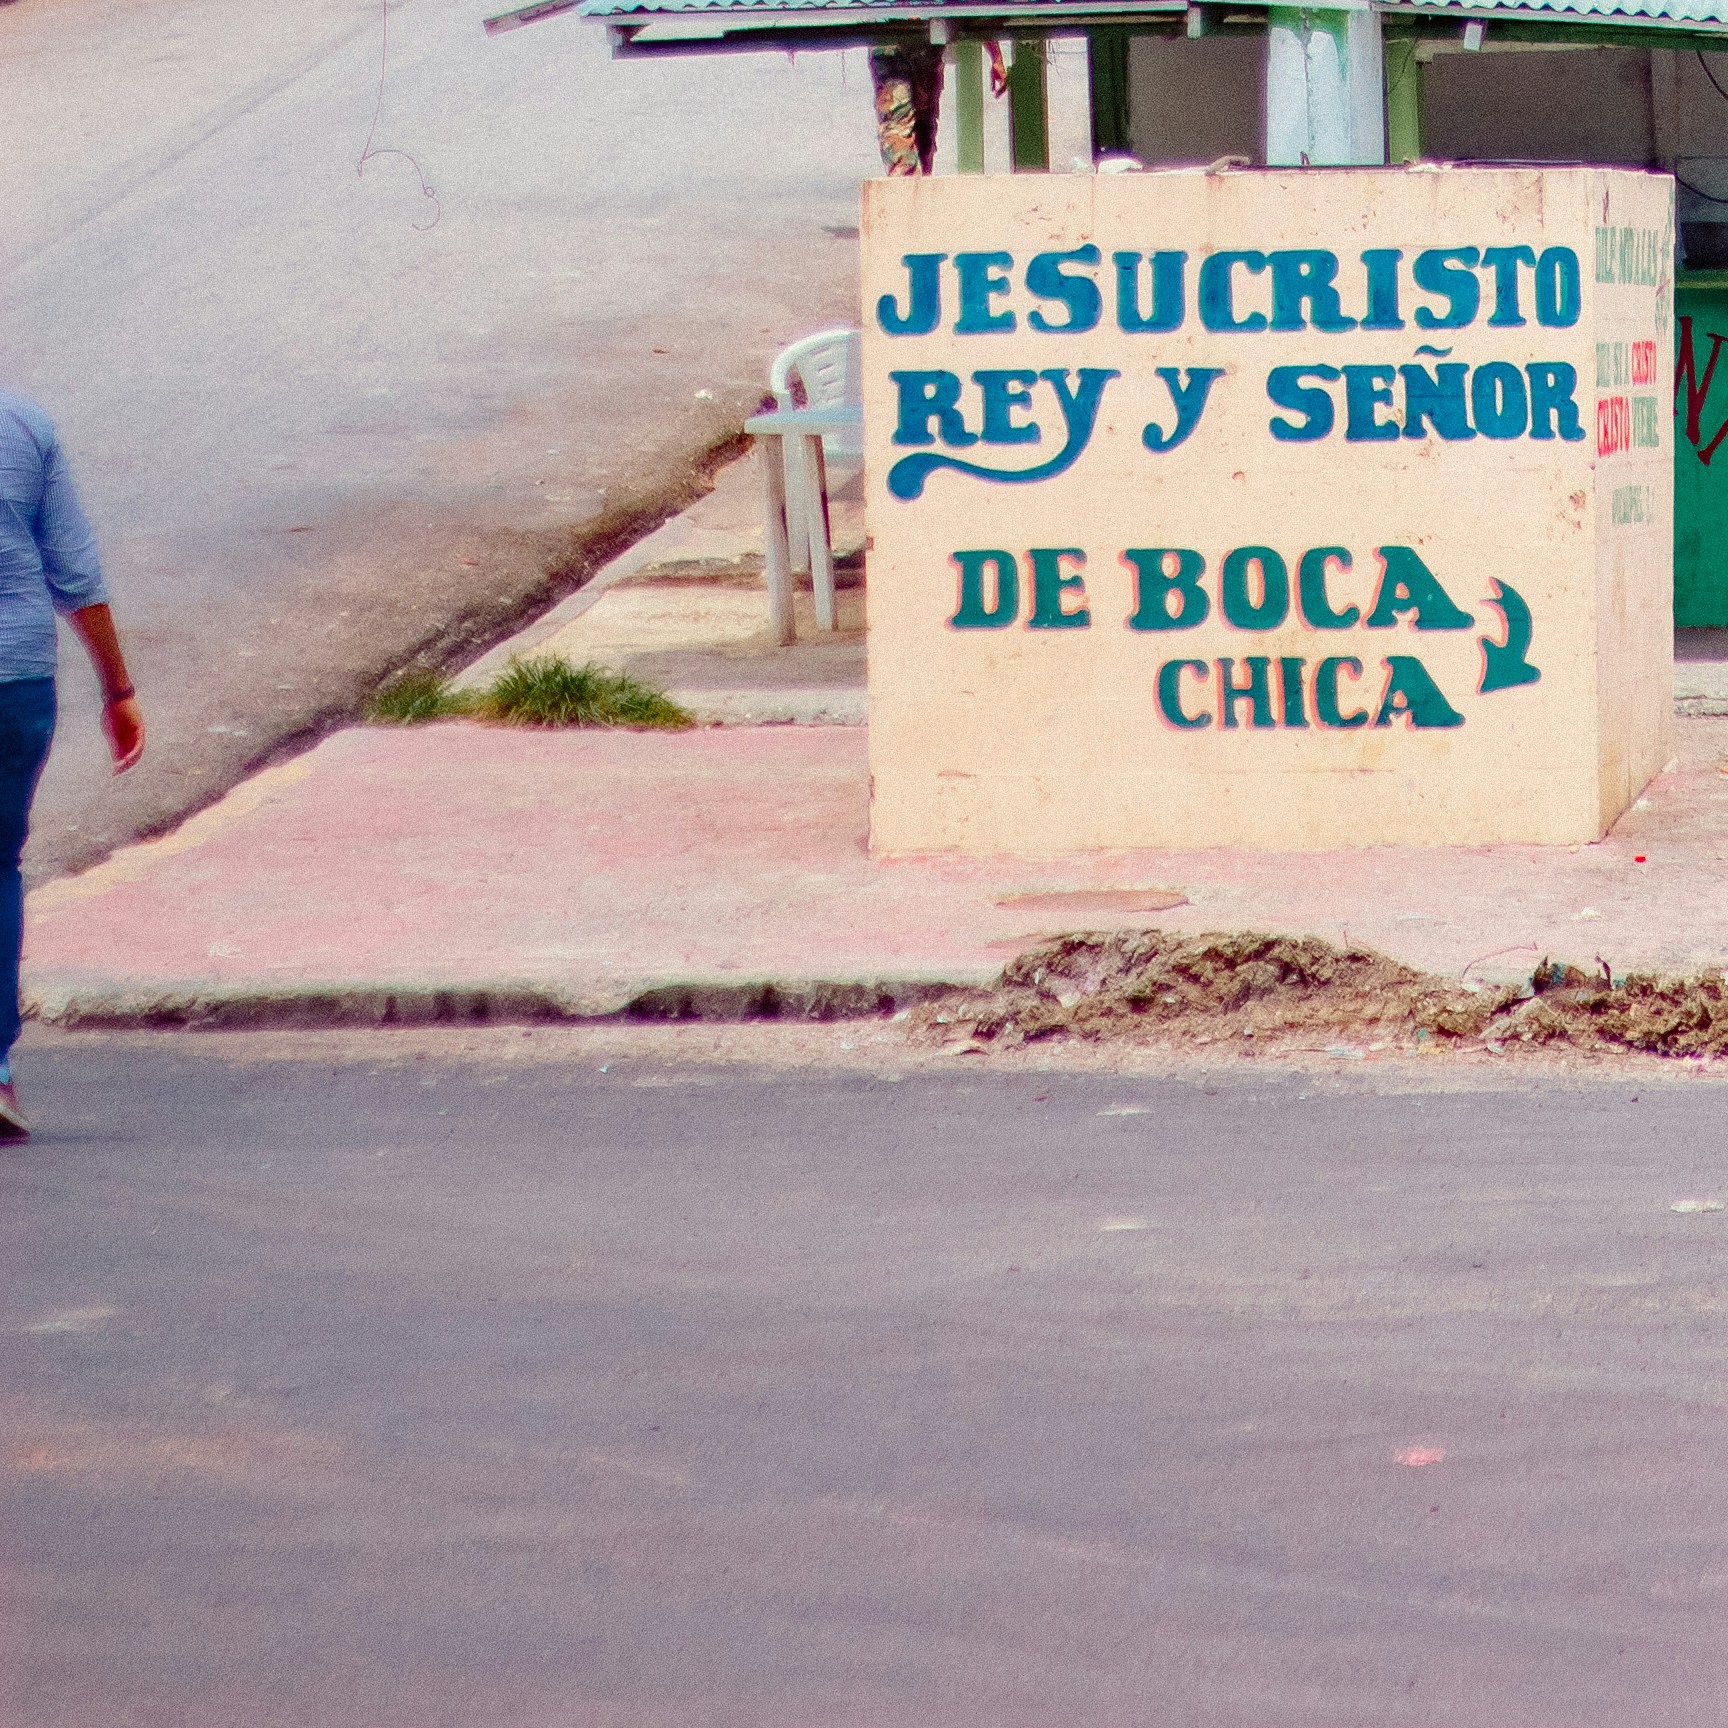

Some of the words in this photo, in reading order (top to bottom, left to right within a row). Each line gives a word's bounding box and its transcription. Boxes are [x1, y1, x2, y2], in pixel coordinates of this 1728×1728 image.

[878, 243, 1583, 334] JESUCRISTO
[1267, 344, 1587, 444] SEÑOR
[948, 546, 1091, 632] DE
[1123, 545, 1475, 633] BOCA
[1155, 654, 1466, 730] CHICA
